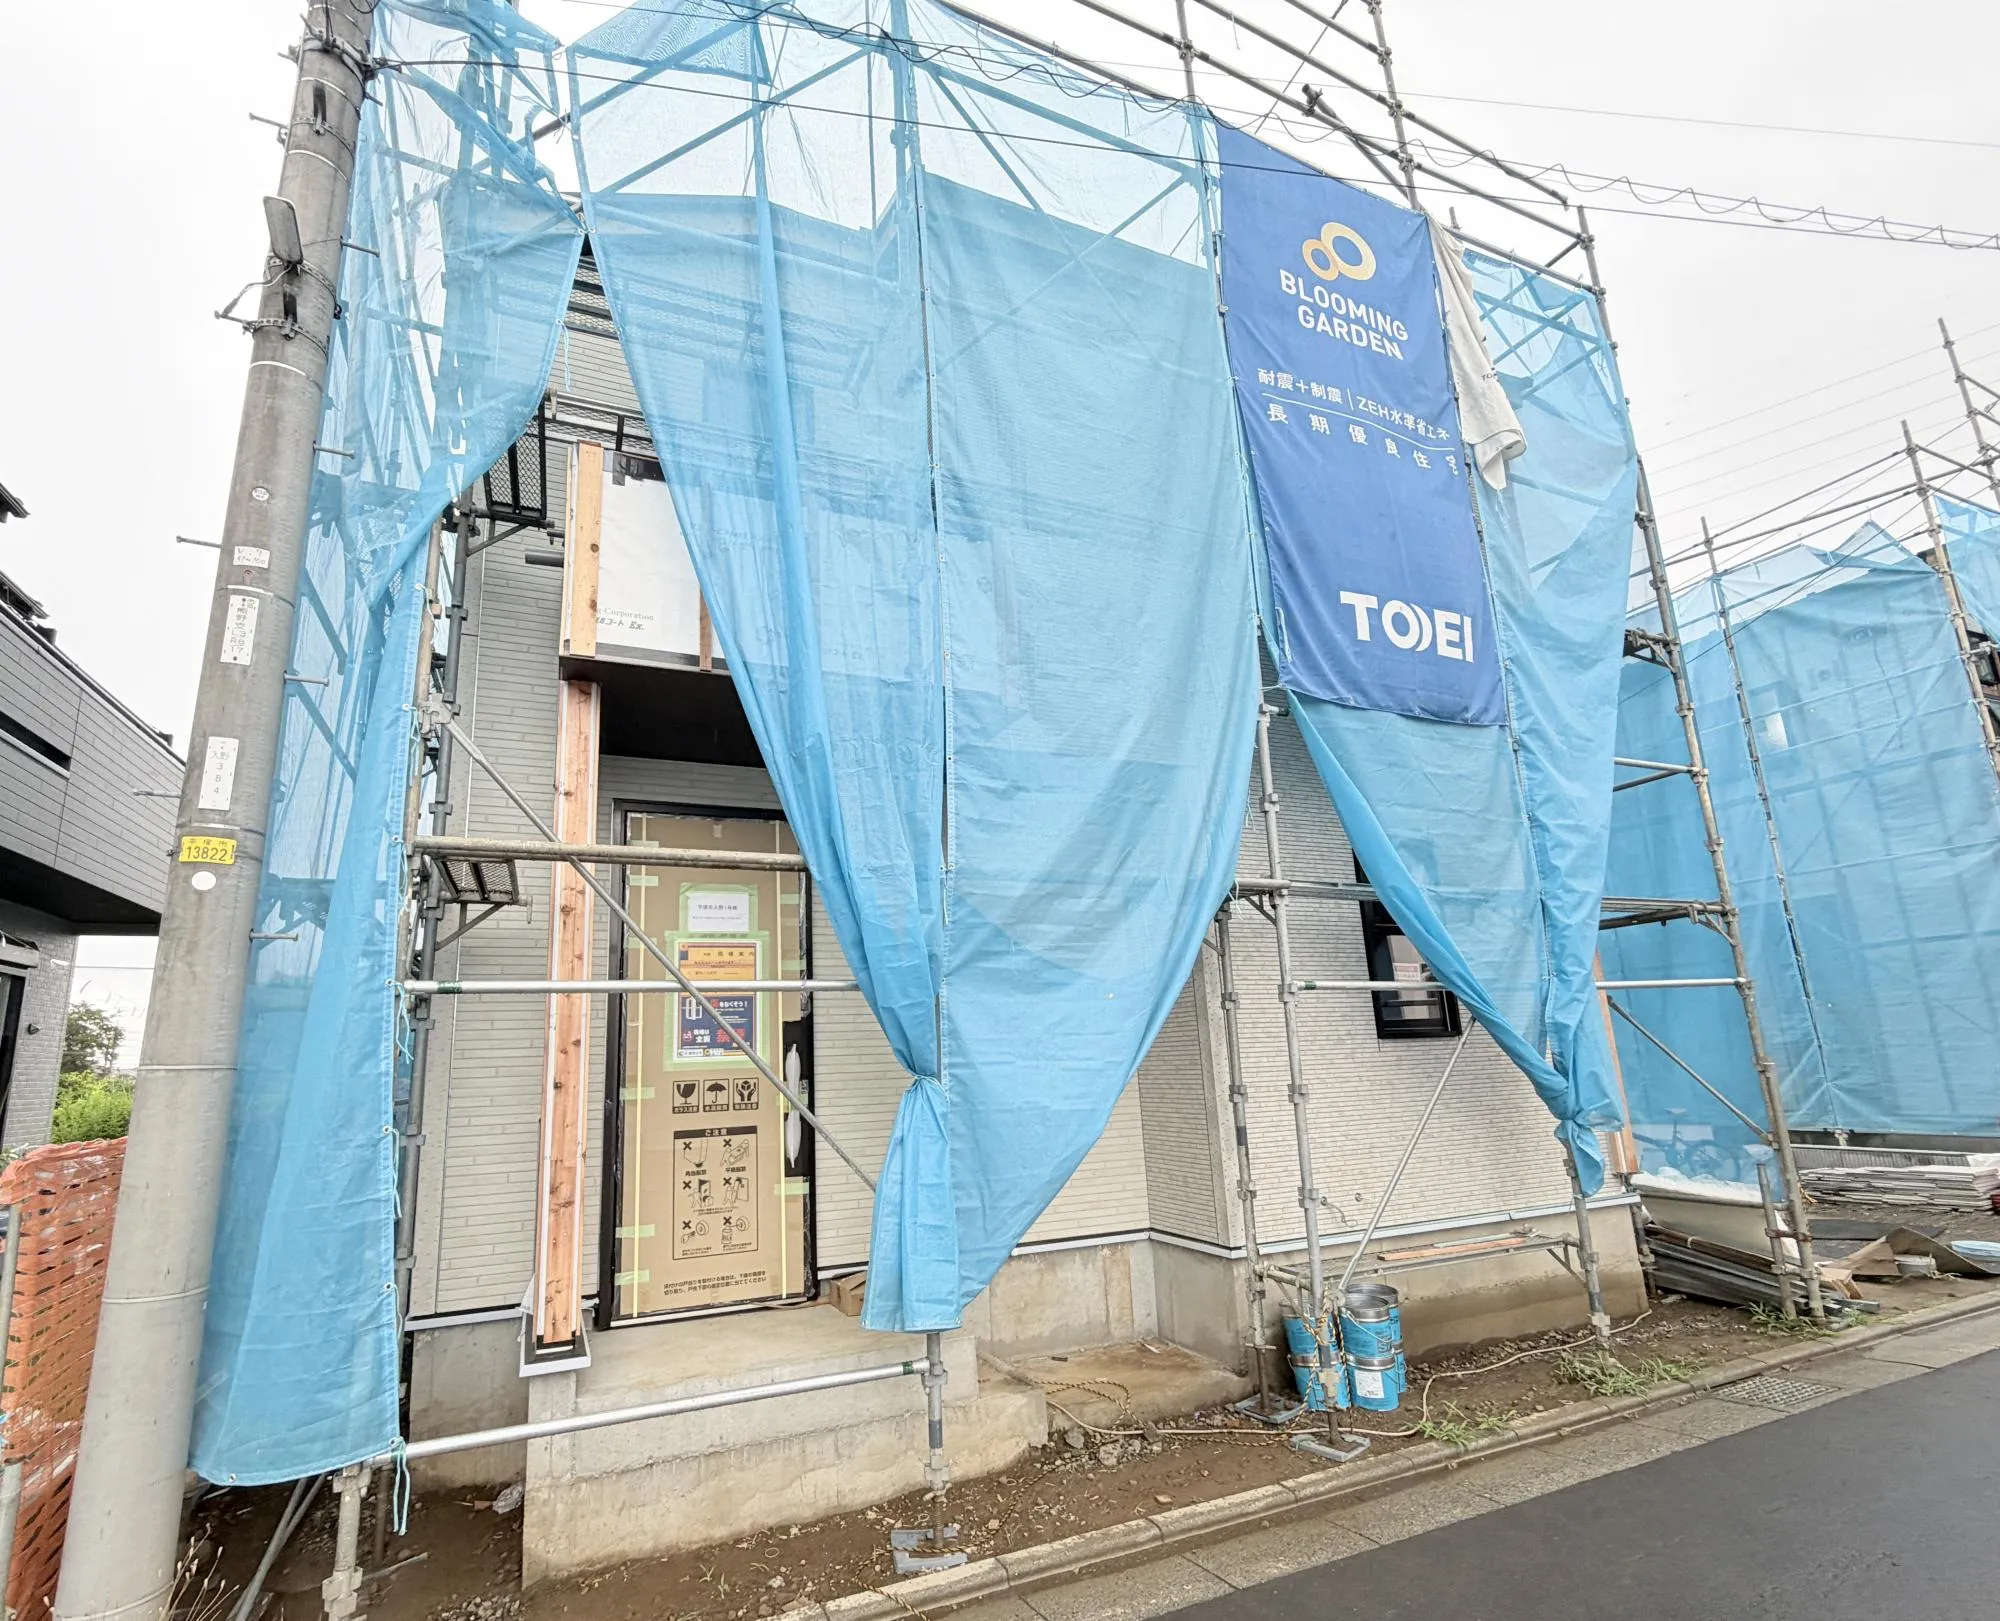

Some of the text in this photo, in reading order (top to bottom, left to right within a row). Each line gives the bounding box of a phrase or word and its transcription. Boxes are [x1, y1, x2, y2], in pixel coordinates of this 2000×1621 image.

[1279, 269, 1409, 341] BLOOMING
[1297, 305, 1404, 361] GARDEN
[604, 607, 655, 621] Corporation
[1339, 590, 1474, 663] TOEI
[186, 846, 229, 862] 13822
